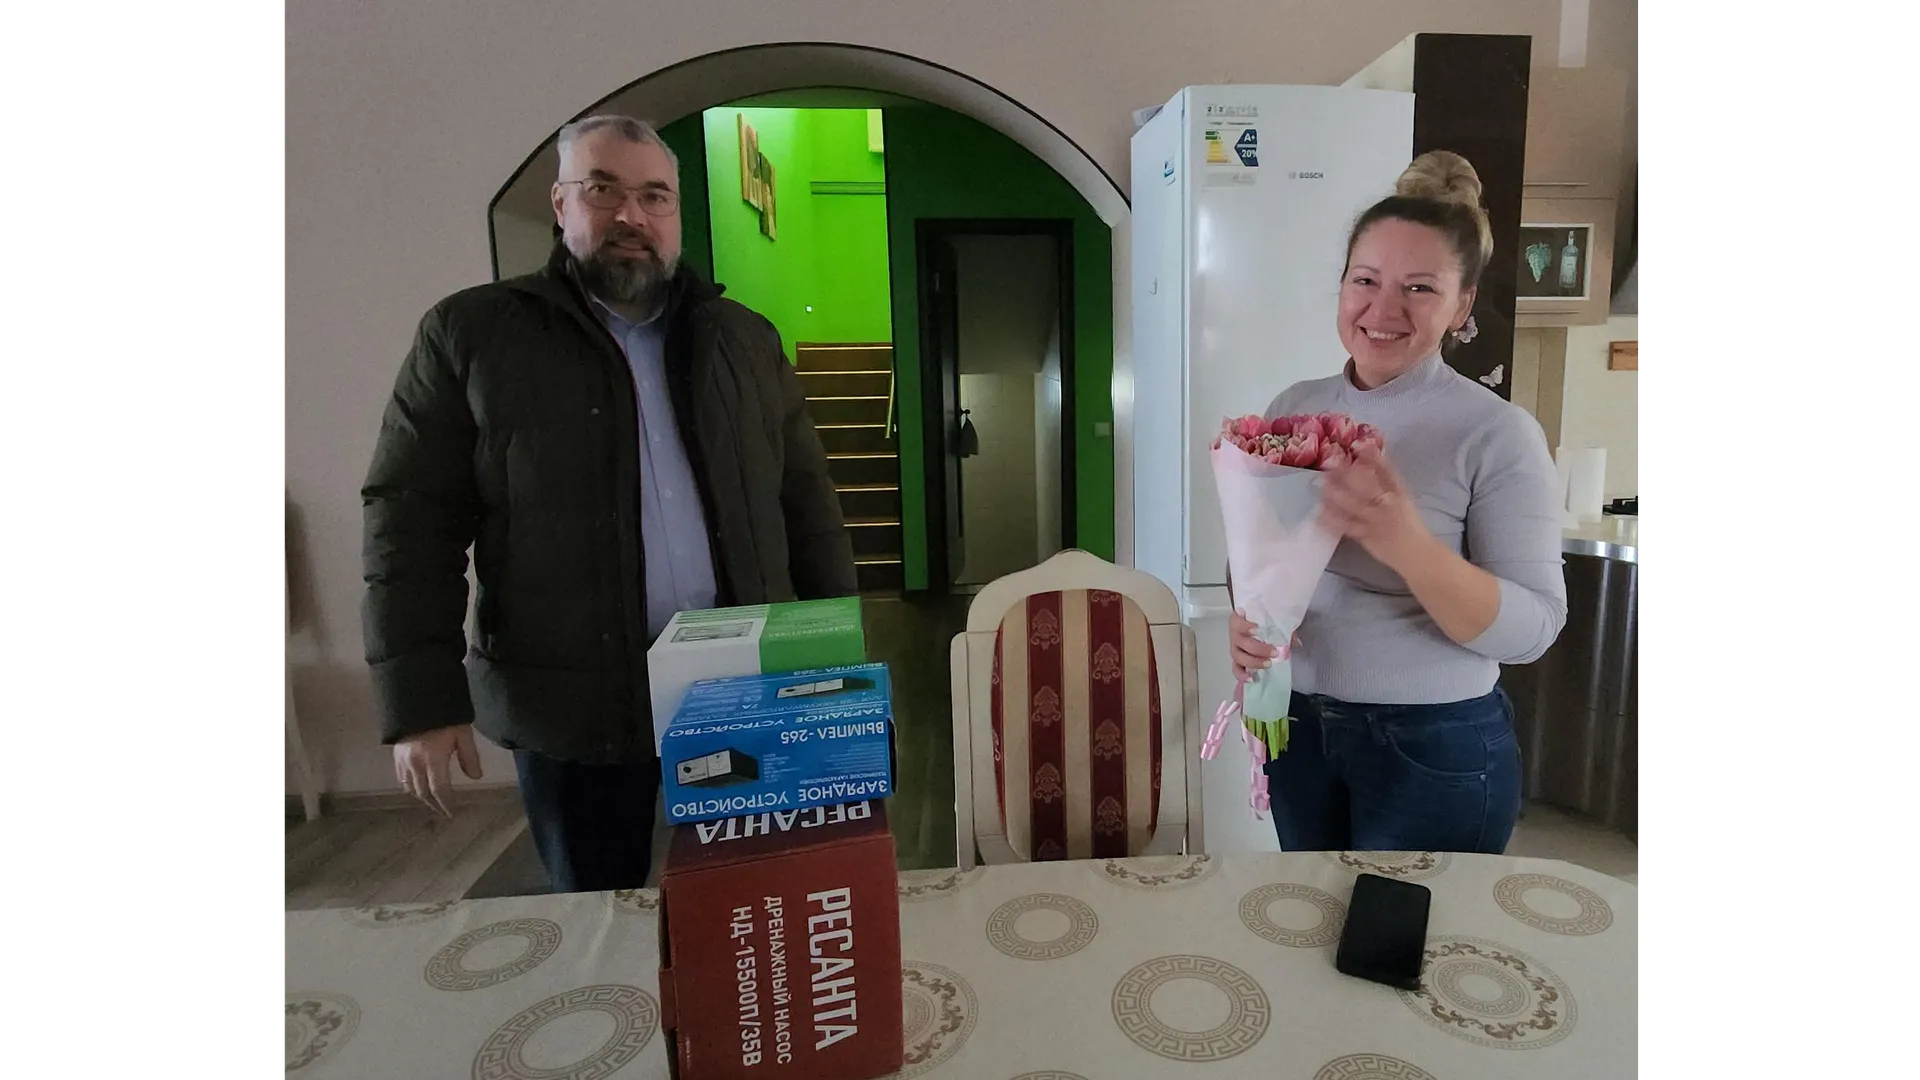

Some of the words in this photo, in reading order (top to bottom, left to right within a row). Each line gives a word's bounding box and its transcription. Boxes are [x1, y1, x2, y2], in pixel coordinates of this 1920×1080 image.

[1243, 133, 1256, 142] A+
[1299, 172, 1324, 180] BOSCH
[795, 707, 884, 724] ЗАРЯДНОЕ
[669, 718, 785, 738] УСТРОЙСТВО
[798, 780, 888, 802] ЗАРЯДНОЕ
[672, 791, 789, 818] УСТРОЙСТВО
[763, 896, 793, 1005] ДРЕНАЖНЫЙ
[806, 887, 858, 1051] РЕСАНТА
[730, 905, 762, 1067] НД-15500П/35В
[774, 1009, 792, 1064] НАСОС
